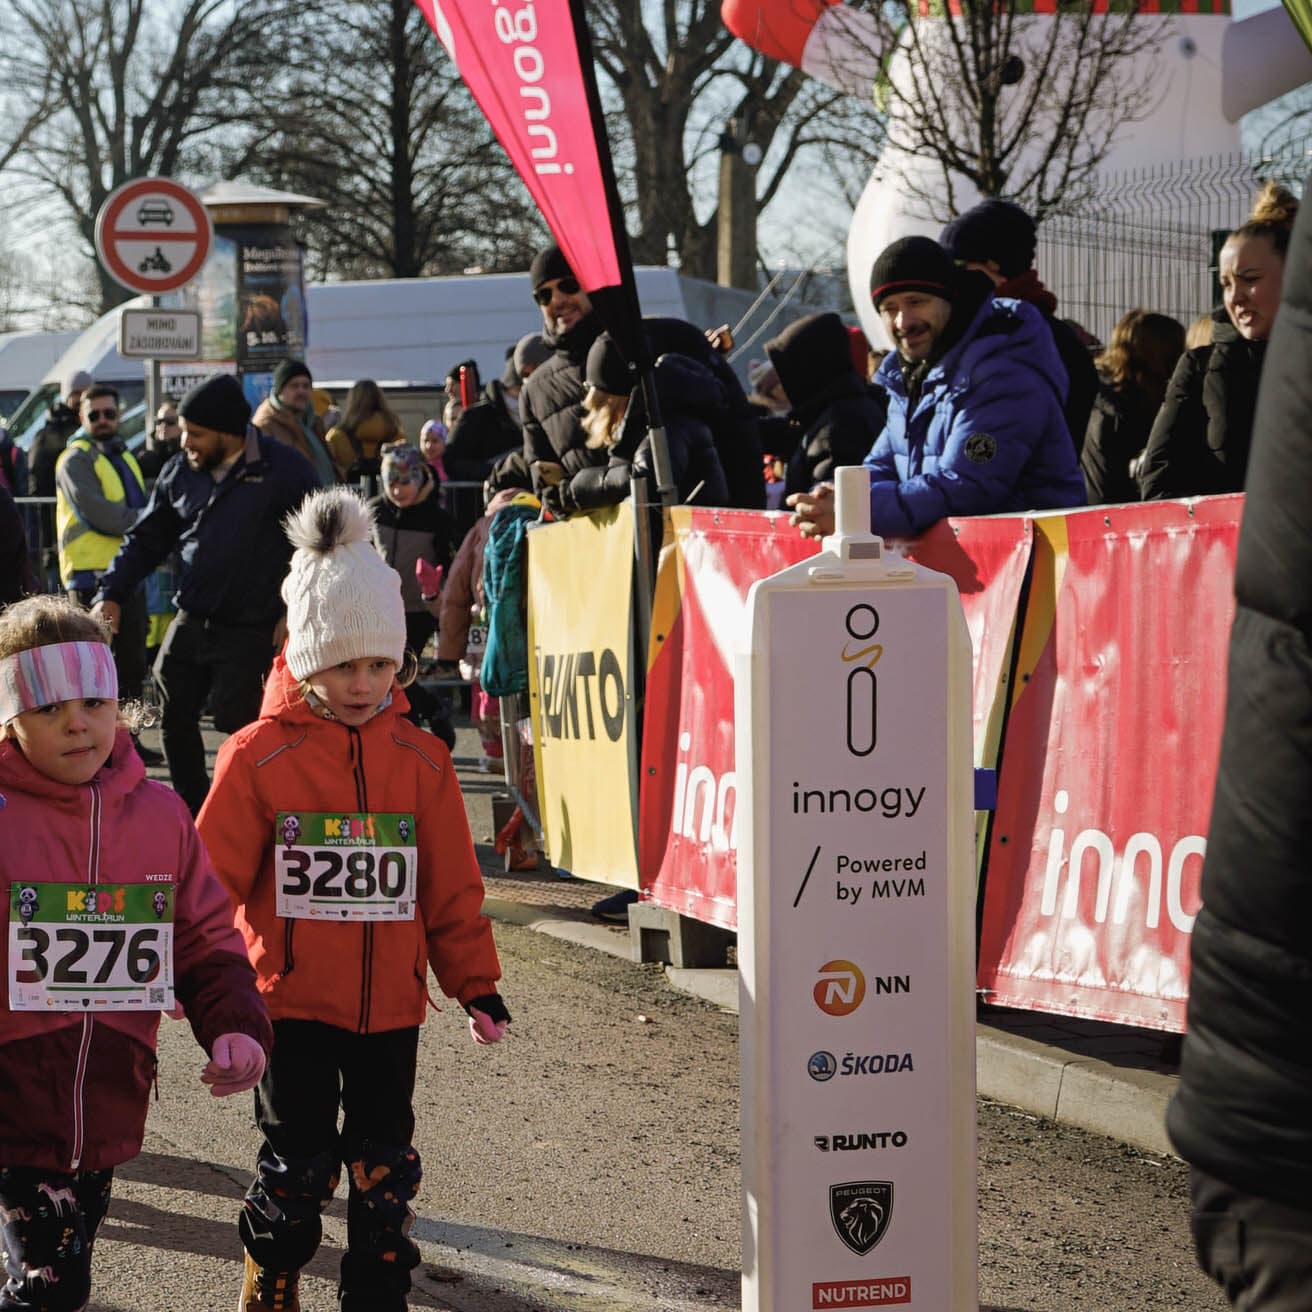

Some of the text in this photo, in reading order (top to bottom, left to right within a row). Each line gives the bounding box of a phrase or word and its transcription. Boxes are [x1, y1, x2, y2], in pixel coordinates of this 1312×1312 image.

[544, 648, 625, 742] RUNTO
[793, 781, 926, 819] innogy
[282, 850, 407, 898] 3280
[836, 851, 927, 873] Powered
[836, 878, 926, 905] by MVM
[16, 927, 161, 984] 3276
[875, 974, 911, 995] NN
[840, 1052, 914, 1076] ŠKODA
[832, 1131, 908, 1151] RUNTO
[836, 1187, 888, 1197] PEUGEOT
[818, 1282, 907, 1304] NUTREND
